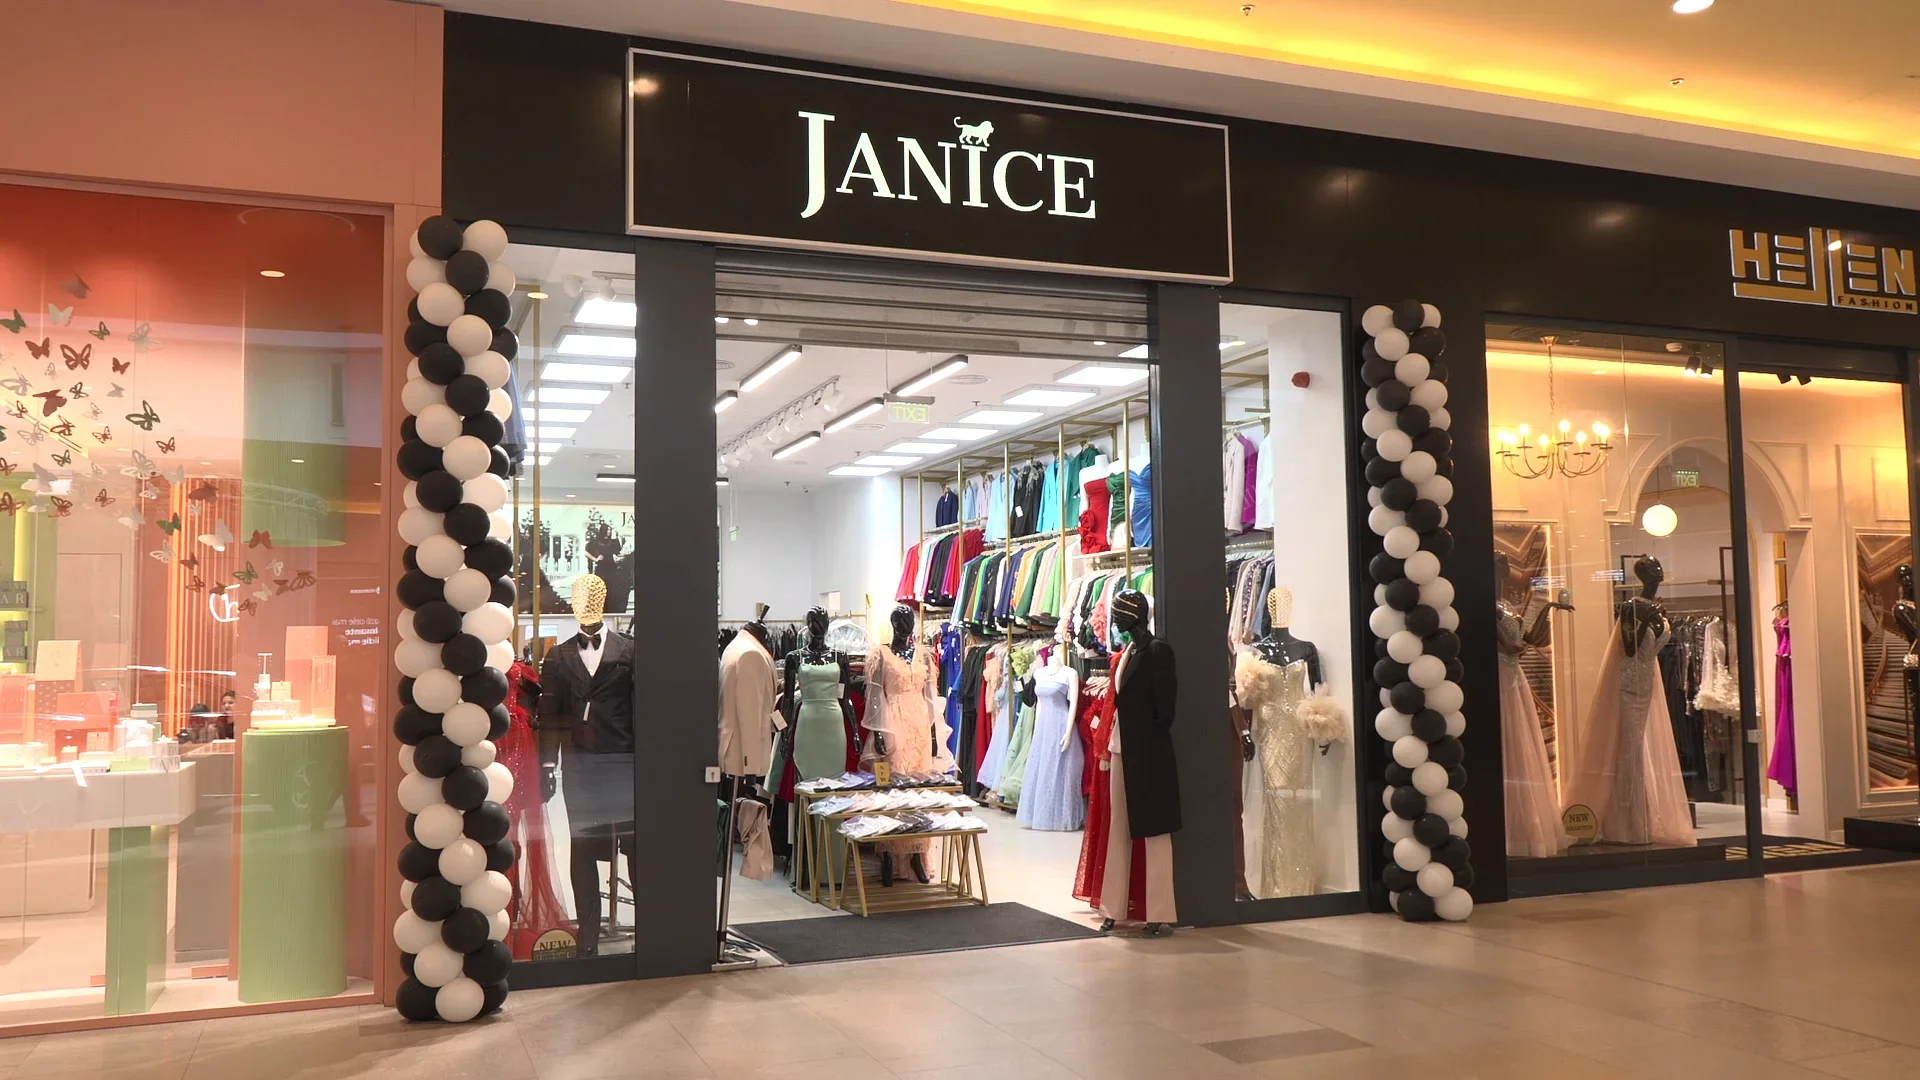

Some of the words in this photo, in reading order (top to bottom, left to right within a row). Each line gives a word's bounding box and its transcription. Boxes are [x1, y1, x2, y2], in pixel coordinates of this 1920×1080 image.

[798, 111, 1096, 219] JANICE
[1838, 296, 1913, 311] FASHION
[1568, 813, 1589, 823] NEW
[539, 939, 571, 952] NEW
